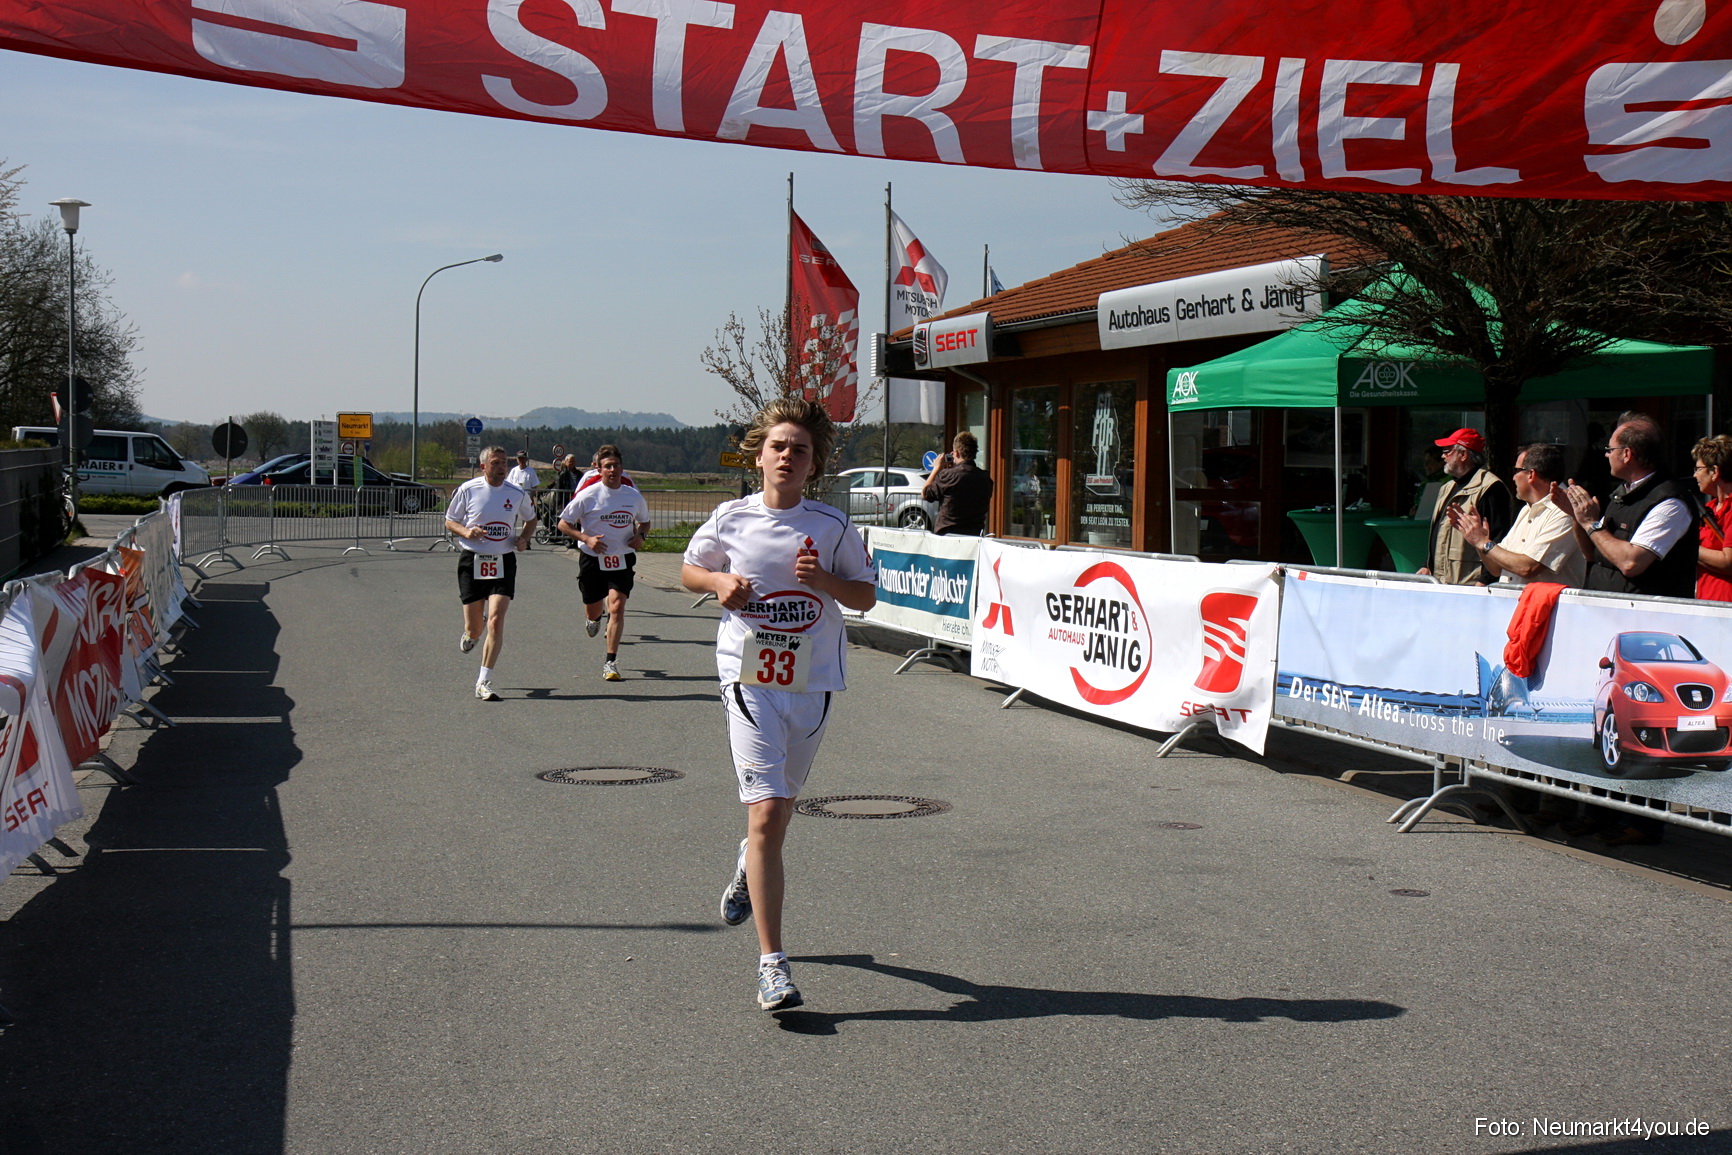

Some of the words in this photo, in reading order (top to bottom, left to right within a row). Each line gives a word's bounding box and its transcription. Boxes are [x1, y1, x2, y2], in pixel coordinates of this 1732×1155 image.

[799, 254, 837, 268] SEA
[1109, 304, 1171, 331] Autohaus
[1176, 293, 1236, 321] Gerhart
[1241, 287, 1255, 312] &
[1260, 284, 1306, 313] Jänig
[935, 328, 978, 353] SEAT
[1172, 370, 1199, 398] AOK
[1352, 361, 1418, 390] AOK
[1349, 390, 1360, 398] Die
[480, 562, 497, 577] 65
[604, 555, 620, 568] 69
[808, 601, 814, 609] &
[1045, 591, 1130, 634] GERHART
[1131, 610, 1139, 632] &
[769, 610, 817, 624] JÄNIG
[755, 639, 787, 649] WERBUNG
[756, 631, 787, 642] MEYER
[1048, 627, 1086, 646] AUTOHAUS
[1083, 631, 1142, 673] JÄNIG
[756, 648, 796, 686] 33
[1289, 676, 1317, 703] Der
[1320, 682, 1353, 713] SEAT
[1358, 693, 1405, 725] Altea.
[1409, 707, 1445, 732] Cross
[1451, 715, 1474, 737] the
[4, 780, 49, 833] SEA
